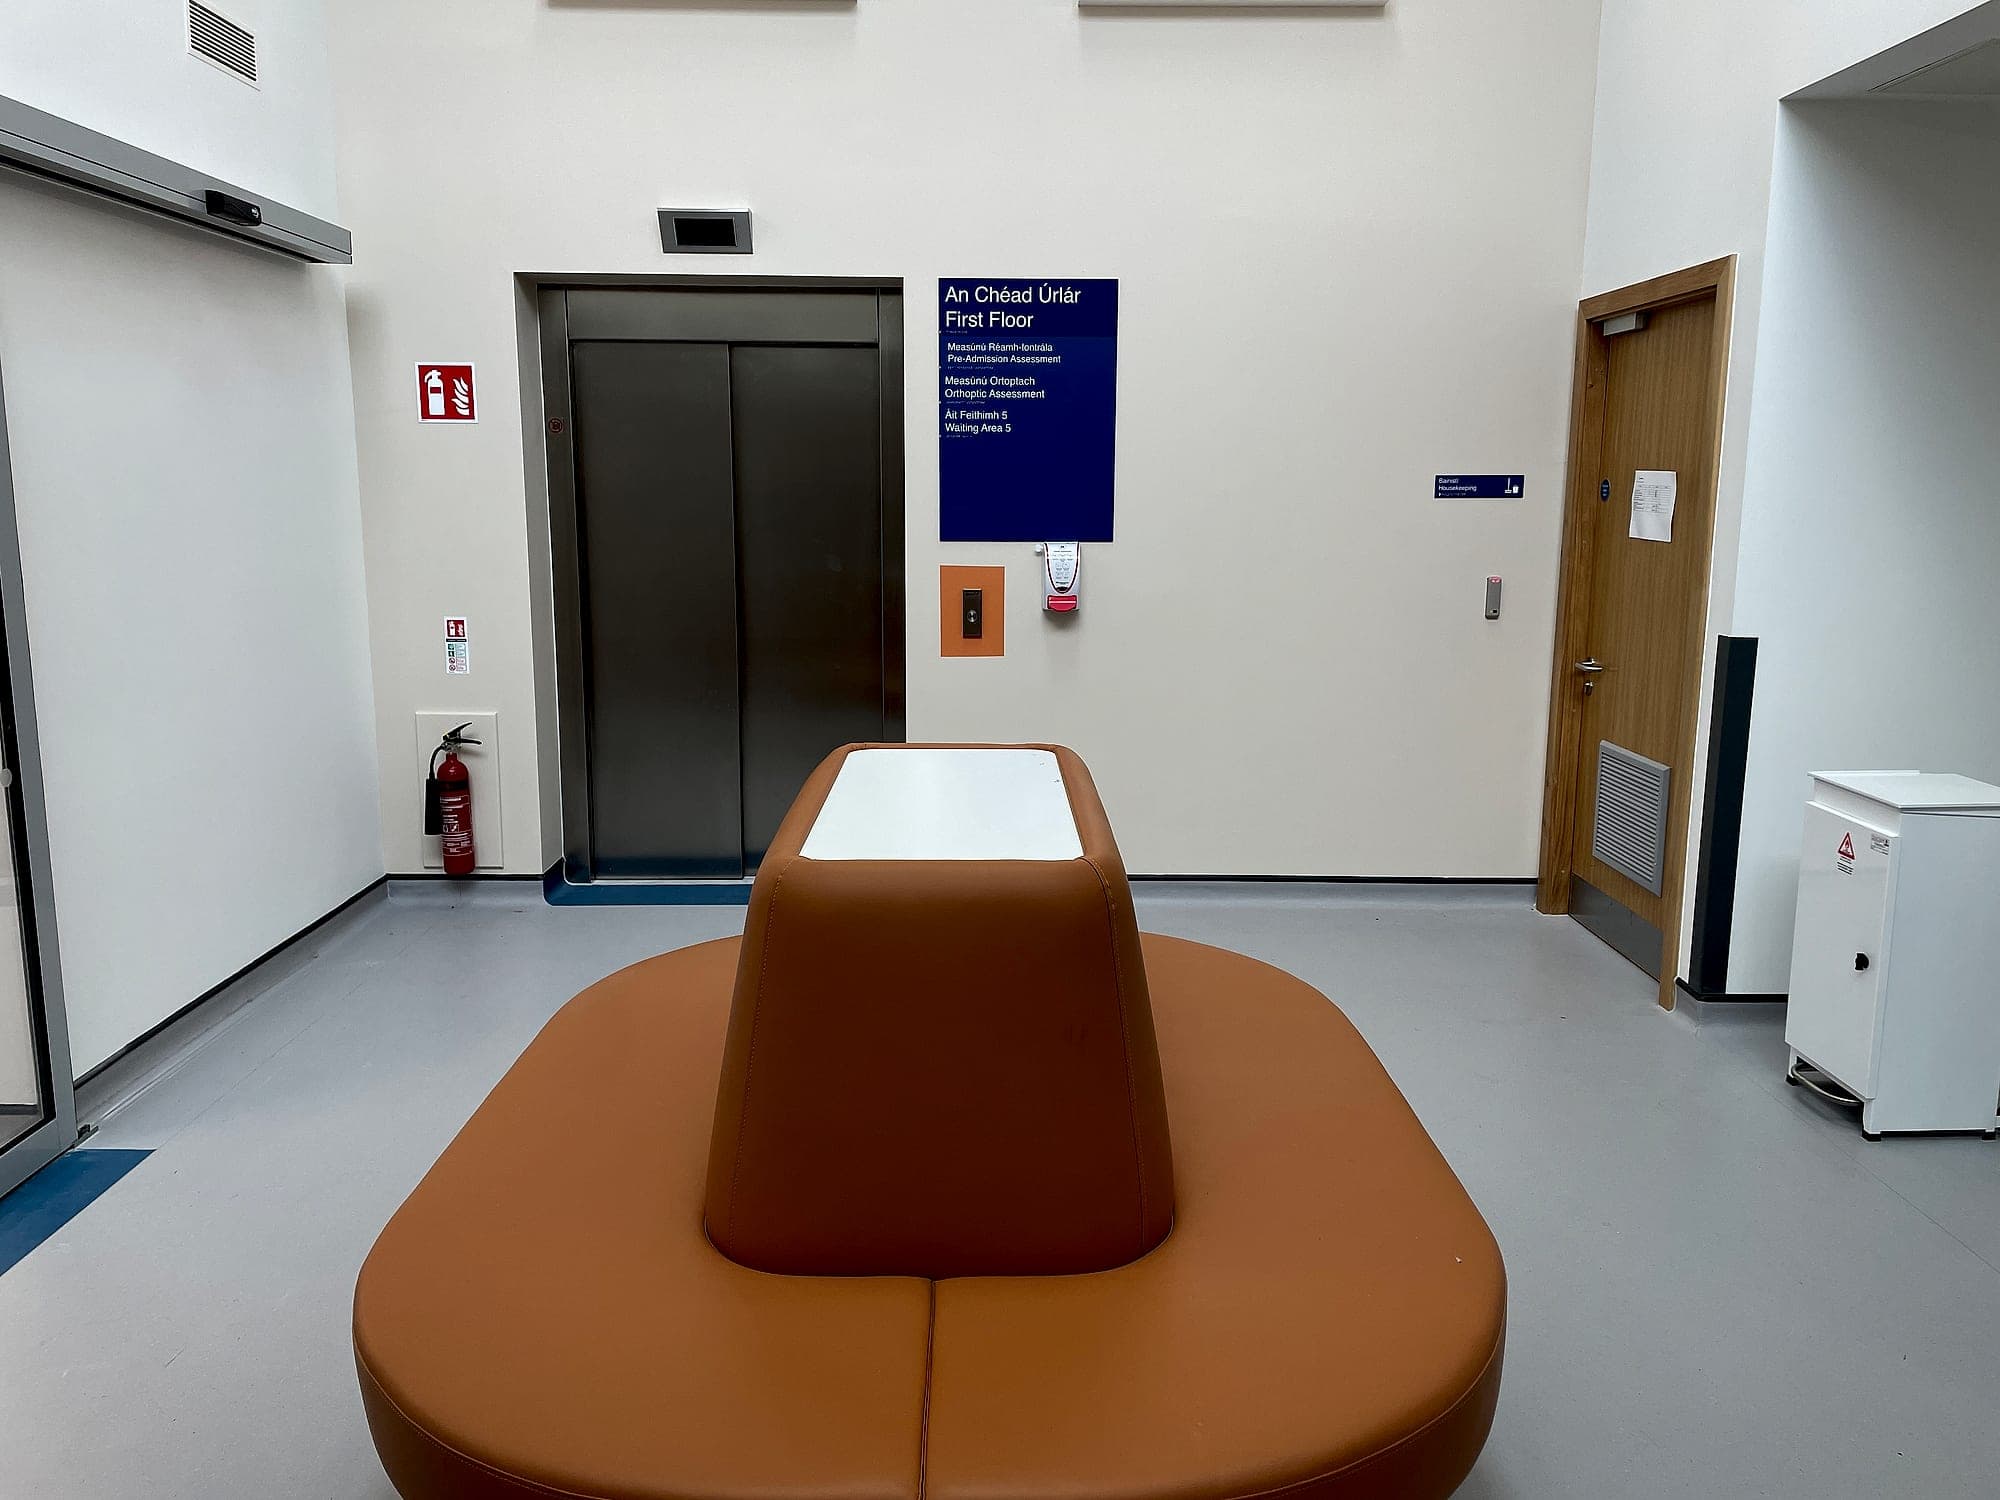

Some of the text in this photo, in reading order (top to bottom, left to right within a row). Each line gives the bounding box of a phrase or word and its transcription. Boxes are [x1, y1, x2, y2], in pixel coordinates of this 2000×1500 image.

[945, 283, 1081, 303] An Chéad Úrlár
[945, 310, 1034, 328] First Floor
[947, 342, 986, 351] Measúnú
[947, 354, 1061, 364] Pre-Admission Assessment
[944, 376, 1035, 388] Measúnú Ortoptach
[944, 388, 1045, 400] Orthoptic Assessment
[944, 408, 1008, 420] Áit Feithimh 5
[945, 423, 1012, 434] Waiting Area 5
